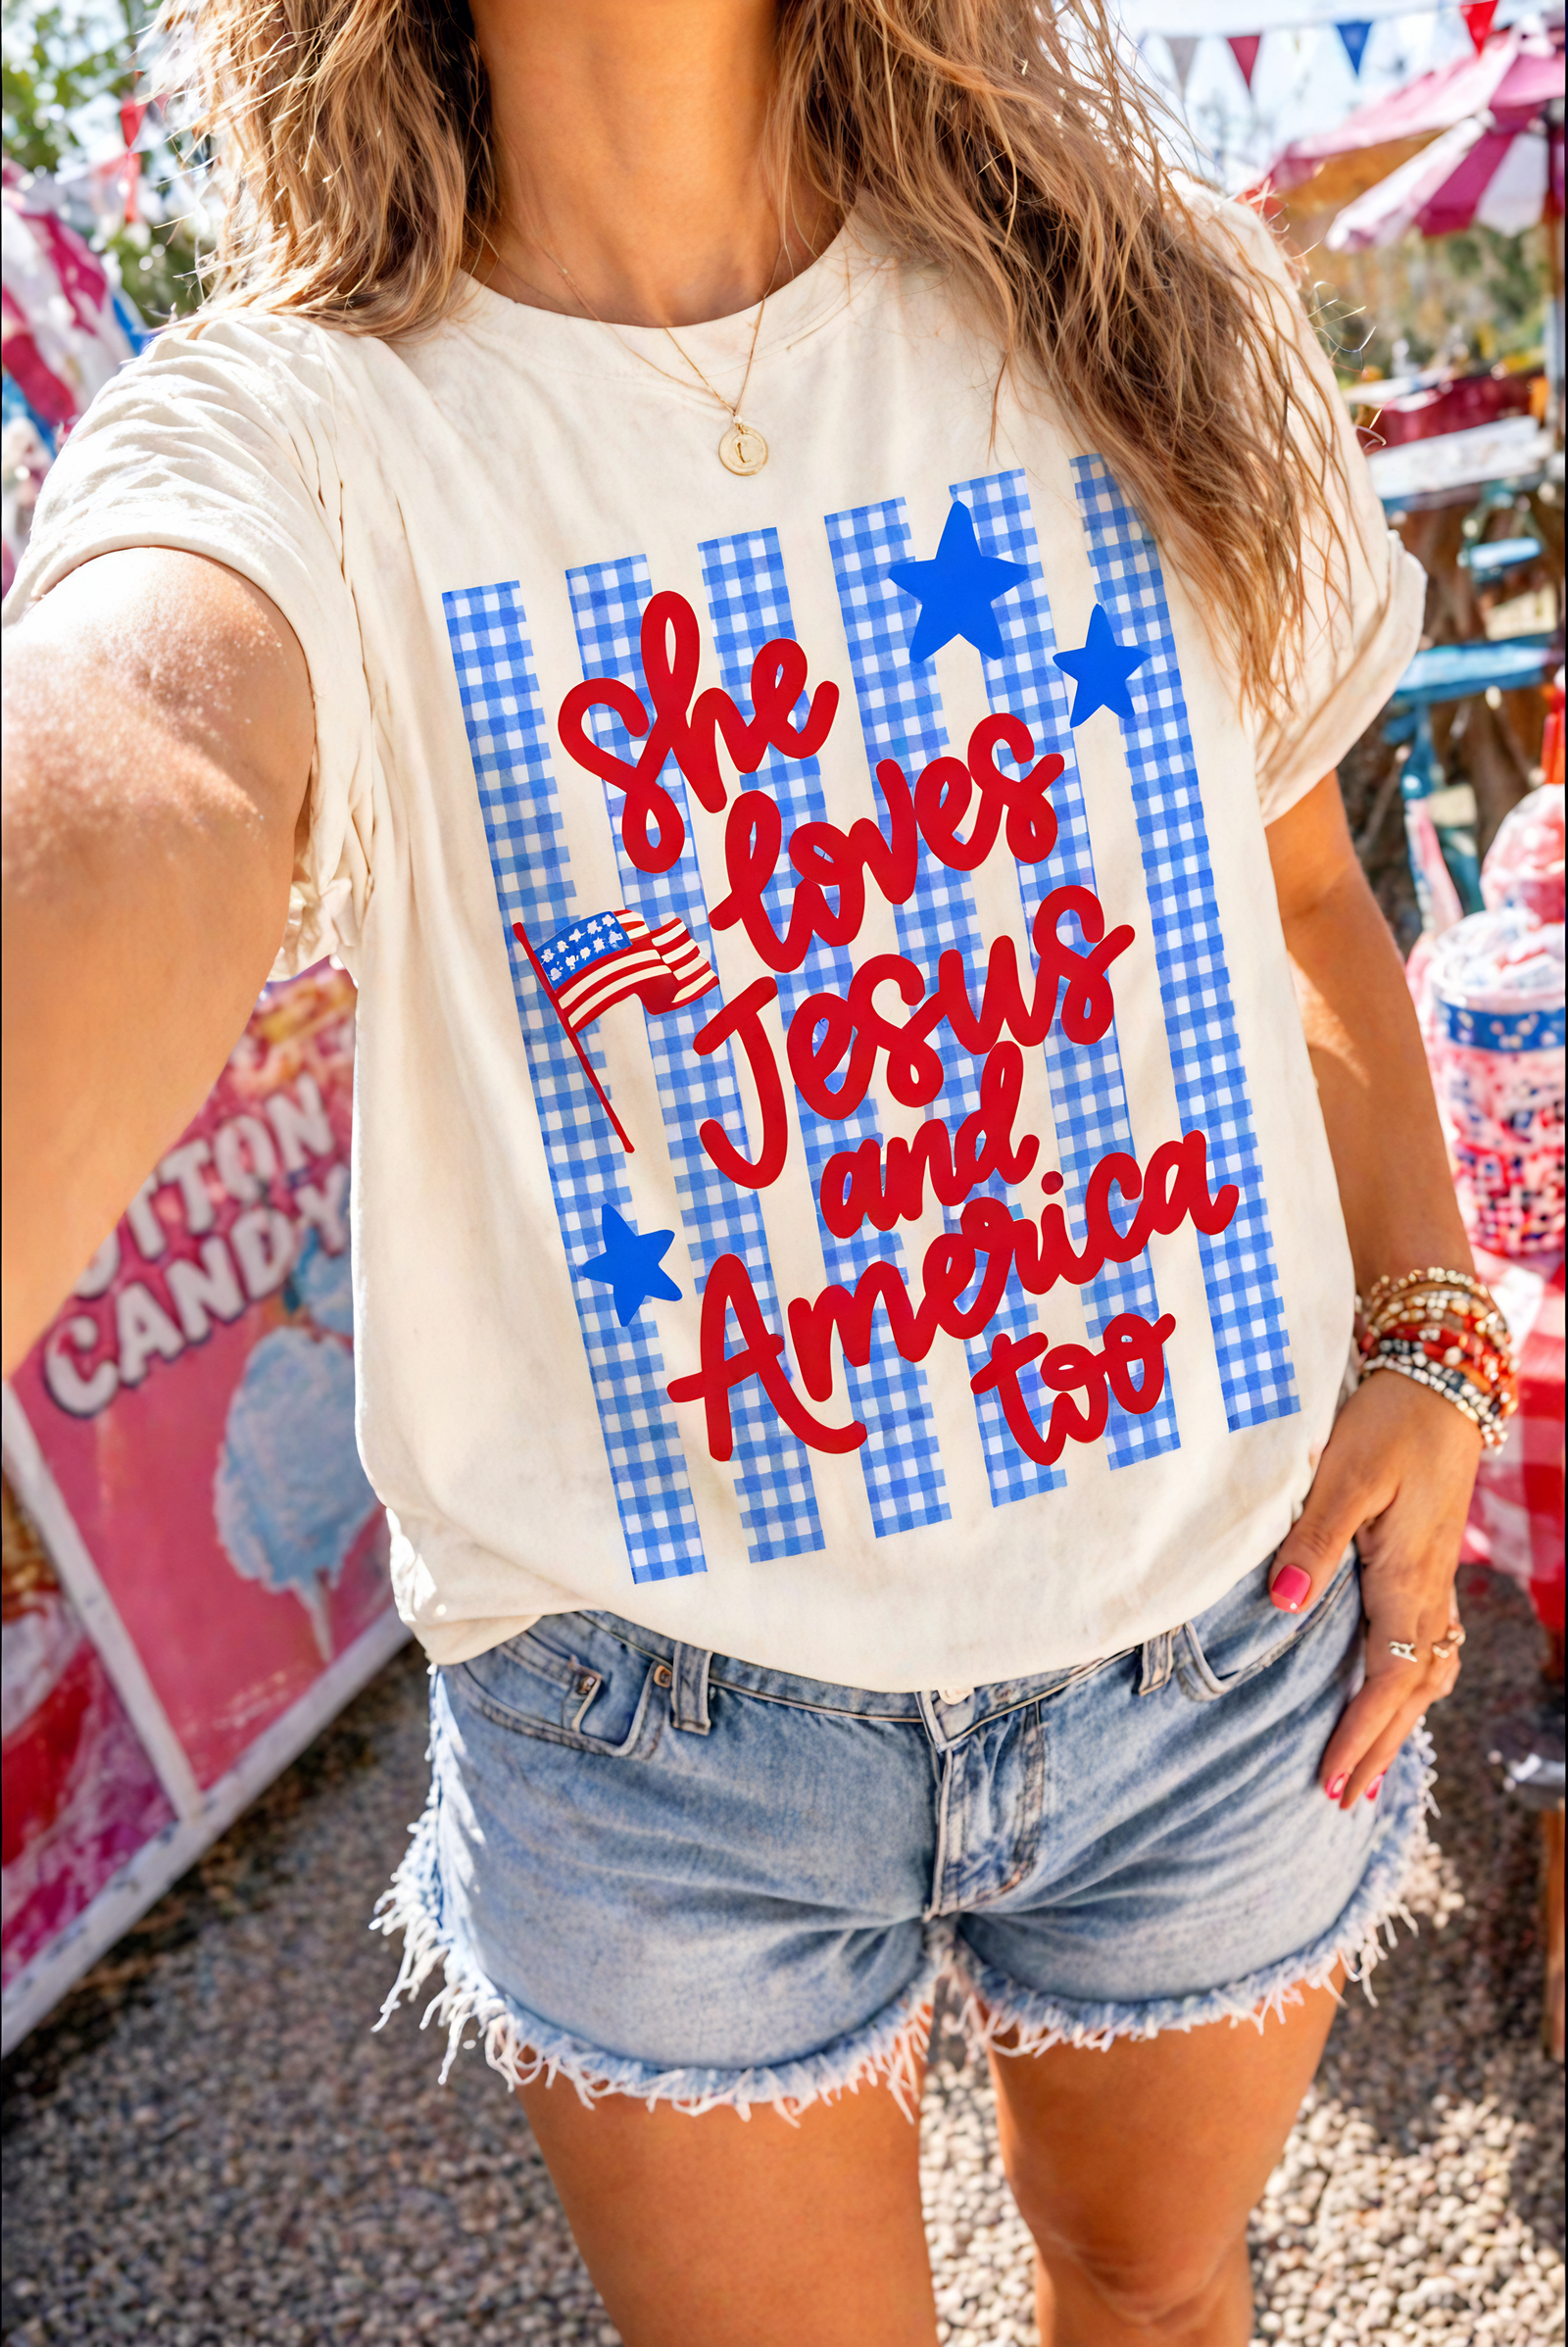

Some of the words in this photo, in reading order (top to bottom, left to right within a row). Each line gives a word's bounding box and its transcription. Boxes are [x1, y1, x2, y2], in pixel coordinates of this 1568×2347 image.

[557, 589, 841, 875] She
[707, 711, 1066, 974] loves
[691, 884, 1137, 1191] Jesus
[818, 1039, 1041, 1241] and
[44, 1165, 350, 1417] CANDY
[665, 1128, 1241, 1463] America
[968, 1311, 1177, 1467] too
